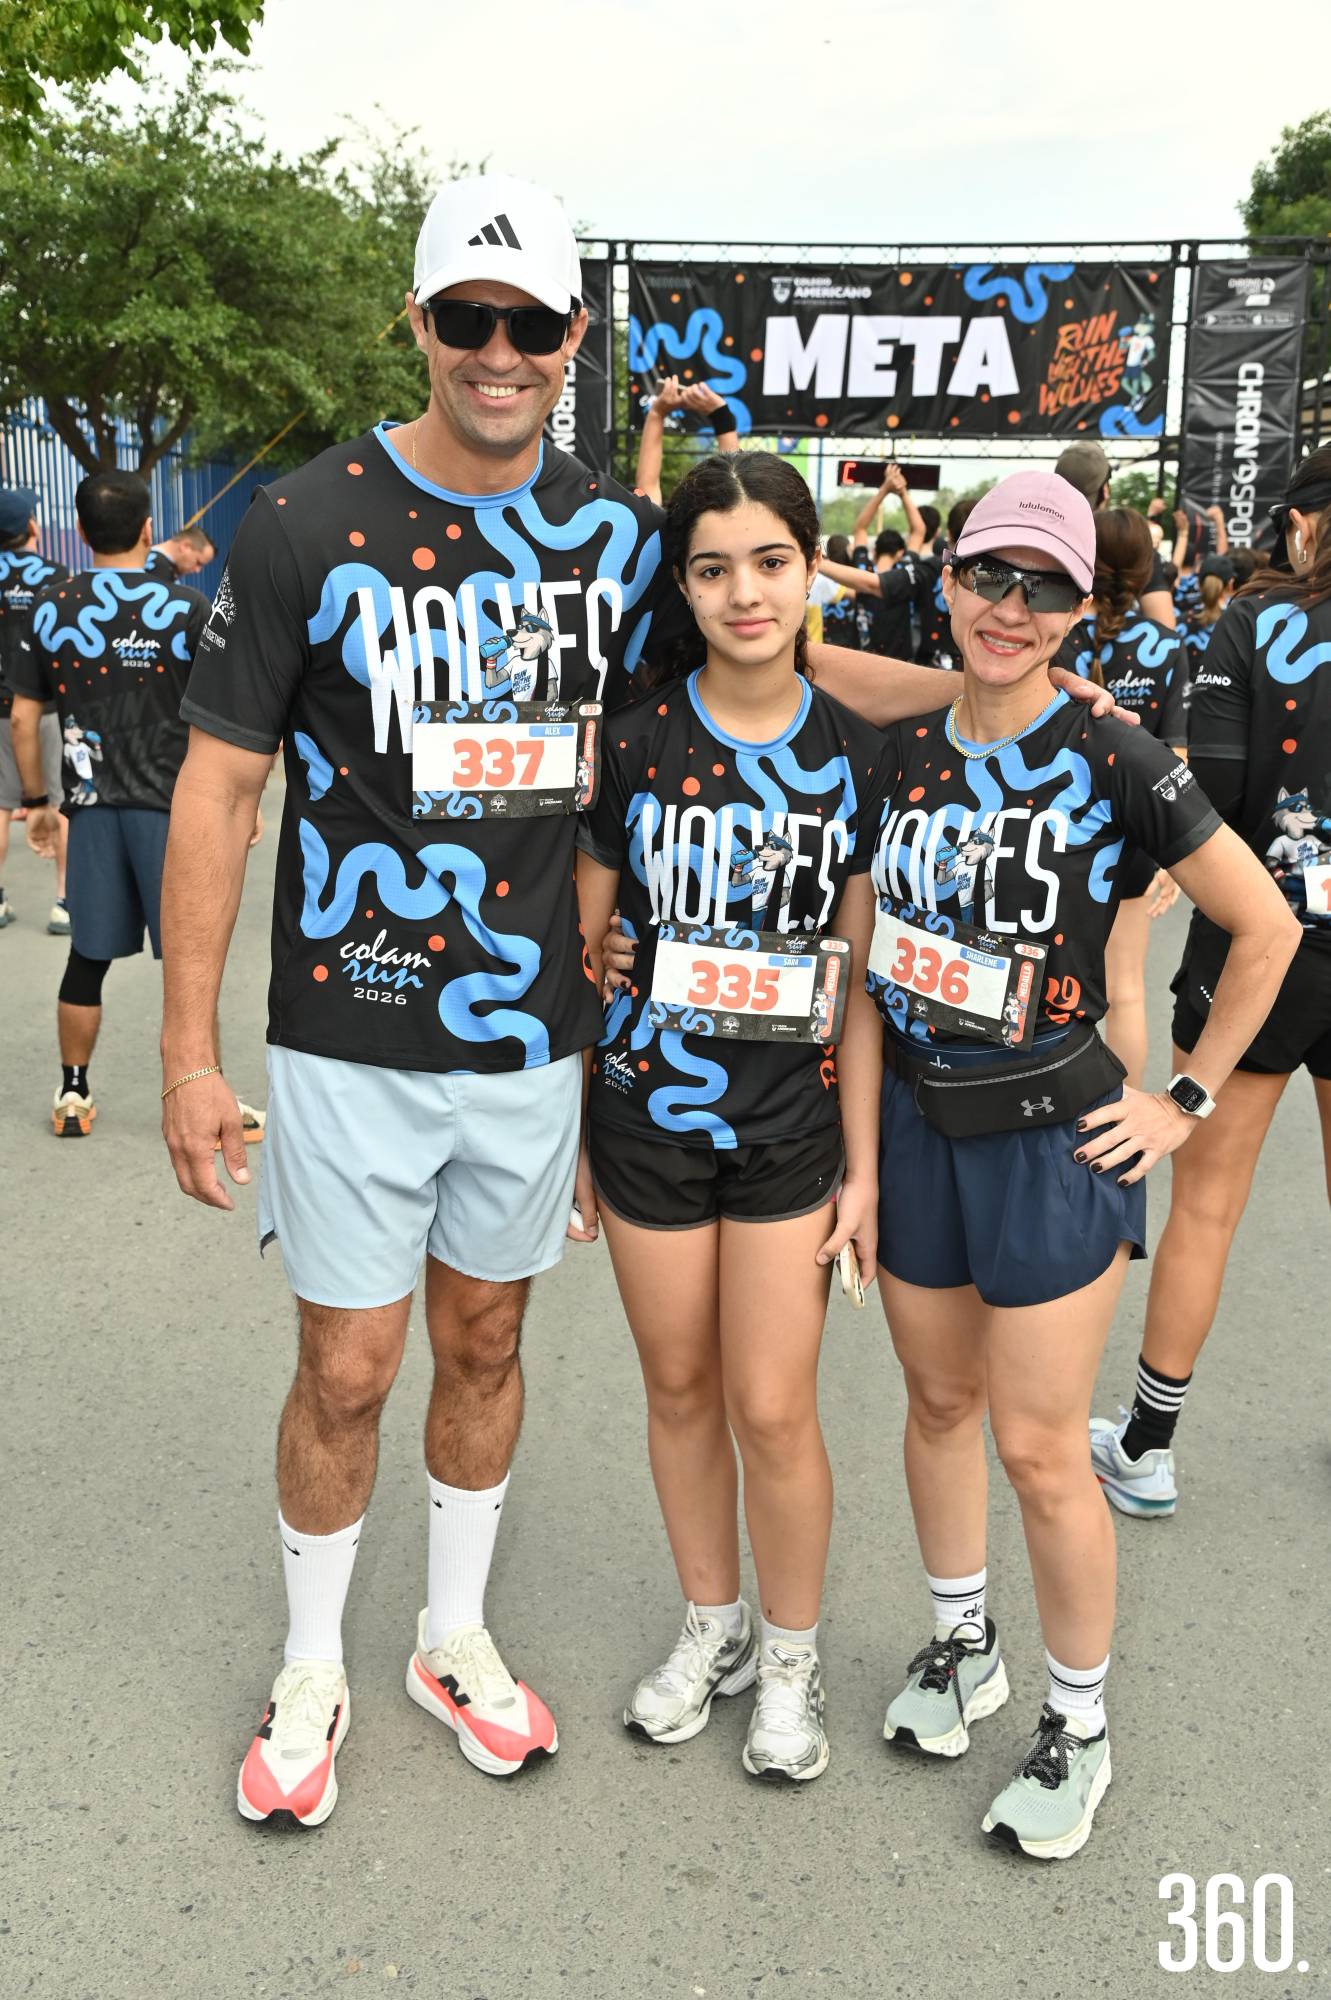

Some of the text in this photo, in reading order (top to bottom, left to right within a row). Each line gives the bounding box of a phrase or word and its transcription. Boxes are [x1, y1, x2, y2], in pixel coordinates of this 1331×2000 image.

[1054, 310, 1118, 360] RUN
[762, 314, 1020, 399] META
[1039, 366, 1124, 416] WOLVES
[1019, 501, 1064, 520] lululemon
[112, 630, 161, 649] colam
[122, 660, 151, 668] 2026
[1107, 669, 1156, 690] colam
[584, 704, 598, 715] 337
[544, 726, 561, 736] ALEX
[585, 724, 595, 757] MEDALLA
[452, 738, 545, 788] 337
[340, 929, 432, 969] colam
[827, 941, 843, 950] 335
[966, 950, 998, 968] SHARLENE
[1020, 944, 1039, 957] 336
[342, 959, 424, 990] run
[827, 960, 837, 992] MEDALLA
[890, 936, 970, 1005] 336
[1019, 965, 1031, 998] MEDALLA
[353, 987, 407, 1005] 2026
[687, 960, 780, 1012] 335
[605, 1051, 636, 1078] colam
[604, 1077, 628, 1095] 2026
